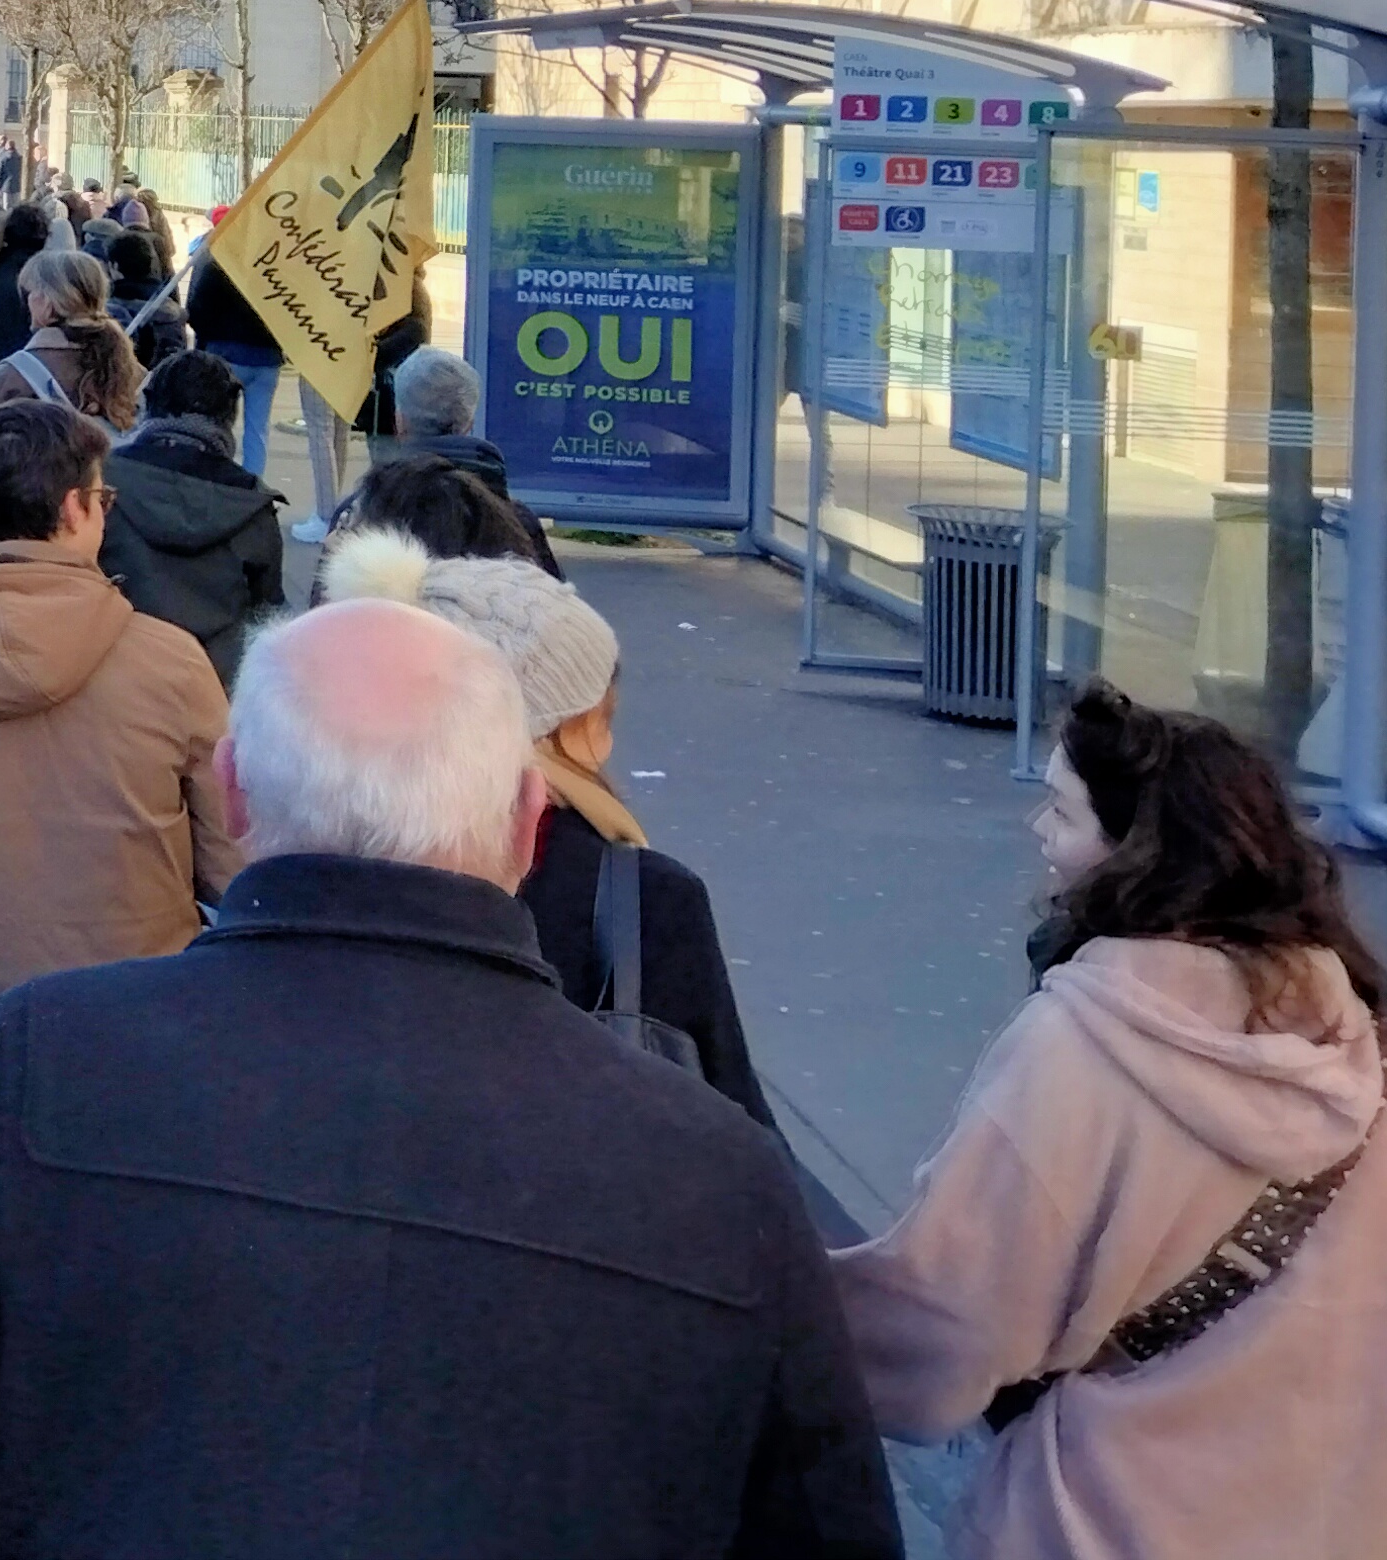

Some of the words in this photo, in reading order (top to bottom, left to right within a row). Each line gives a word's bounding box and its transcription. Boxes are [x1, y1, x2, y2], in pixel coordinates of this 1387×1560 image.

[843, 66, 891, 79] Théâtre
[895, 67, 924, 80] Quai
[927, 70, 935, 79] 3
[854, 100, 867, 116] 1
[900, 101, 914, 118] 2
[948, 102, 961, 120] 3
[993, 105, 1009, 122] 4
[1042, 107, 1055, 124] 8
[564, 163, 653, 186] Guérin
[854, 162, 866, 178] 9
[894, 163, 919, 180] 11
[939, 165, 965, 182] 21
[985, 167, 1012, 184] 23
[517, 268, 694, 293] PROPRIÉTAIRE
[252, 240, 346, 362] Paysanne
[517, 290, 561, 304] DANS
[563, 292, 584, 305] LE
[586, 293, 630, 308] NEUF
[632, 293, 646, 308] À
[647, 297, 694, 311] CAEN
[516, 310, 693, 382] OUI
[515, 381, 576, 399] C'EST
[584, 384, 692, 405] POSSIBLE
